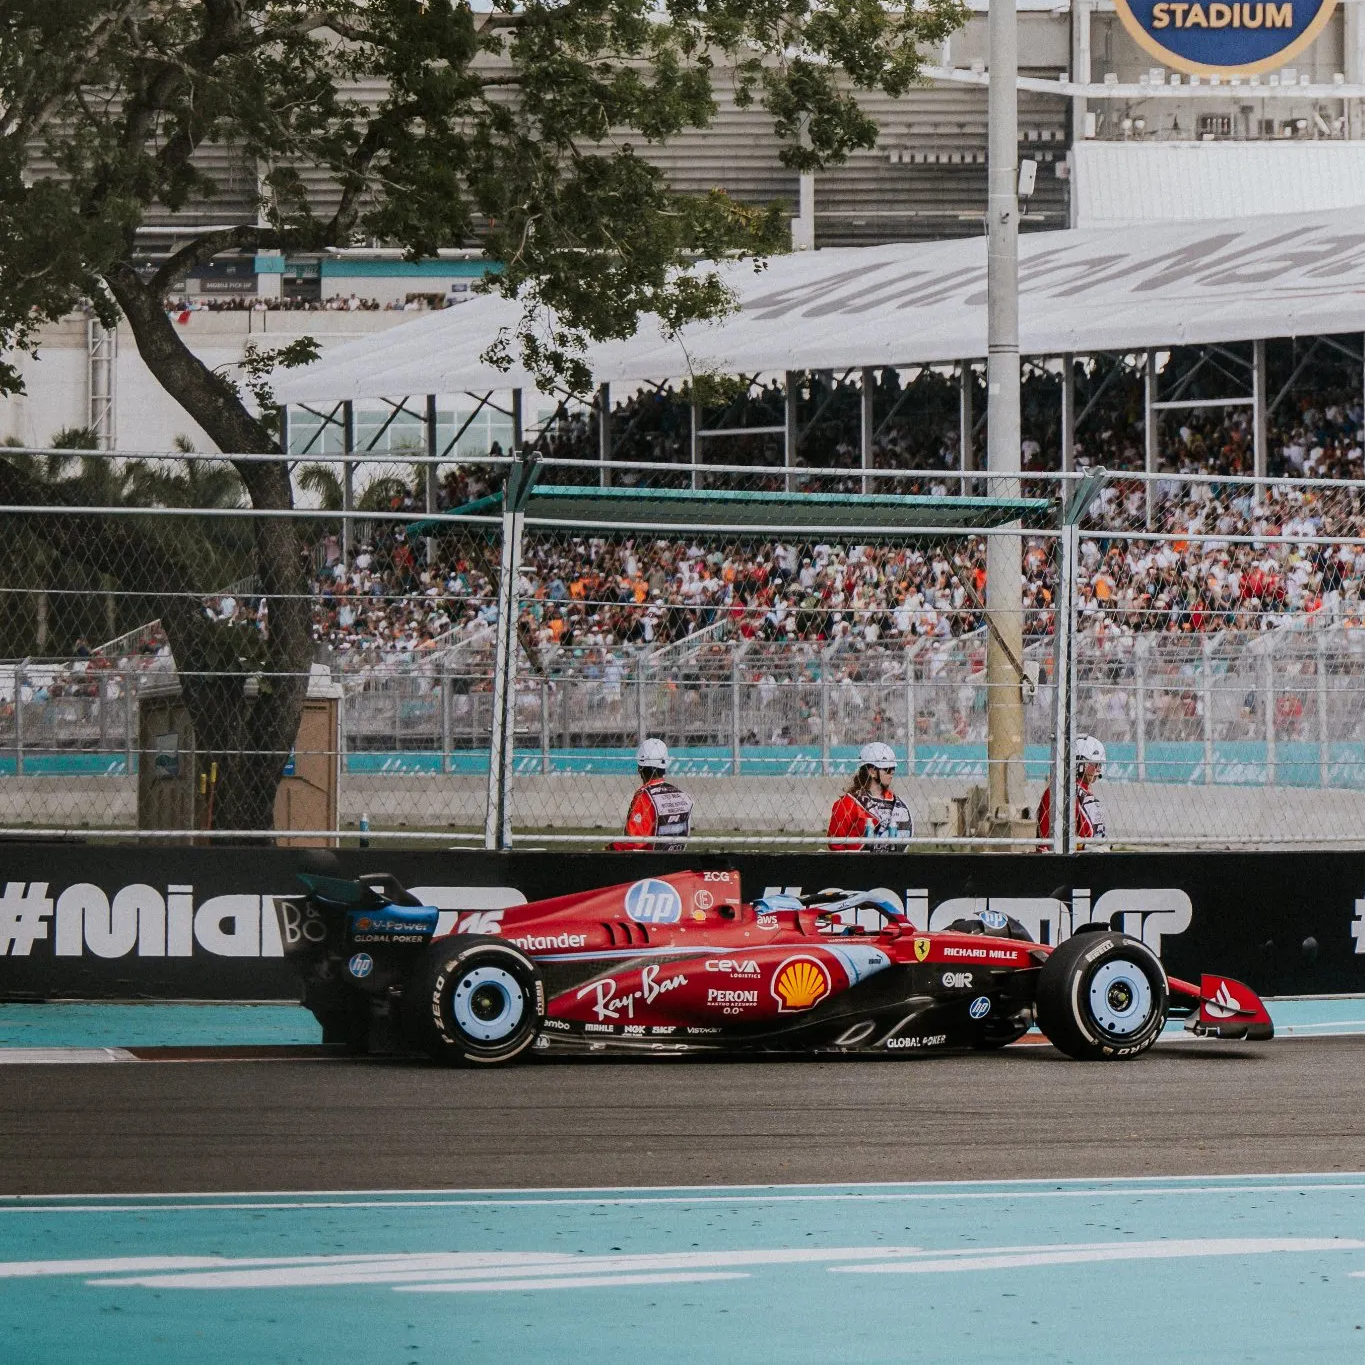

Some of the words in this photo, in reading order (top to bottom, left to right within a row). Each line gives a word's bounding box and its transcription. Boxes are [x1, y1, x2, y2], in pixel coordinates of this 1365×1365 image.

[1152, 2, 1292, 30] STADIUM
[457, 909, 504, 934] 16
[757, 915, 778, 925] aws
[354, 935, 390, 943] GLOBAL
[392, 935, 424, 943] POKER
[944, 947, 987, 958] RICHARD
[989, 949, 1018, 960] MILLE
[351, 954, 372, 978] hp
[707, 988, 758, 1002] PERONI
[432, 975, 445, 1030] ZERO
[970, 996, 991, 1019] hp
[585, 1023, 614, 1032] MAHLE
[624, 1025, 646, 1034] NGK
[652, 1026, 676, 1034] SKF
[887, 1037, 920, 1048] GLOBAL
[922, 1035, 947, 1046] POKER
